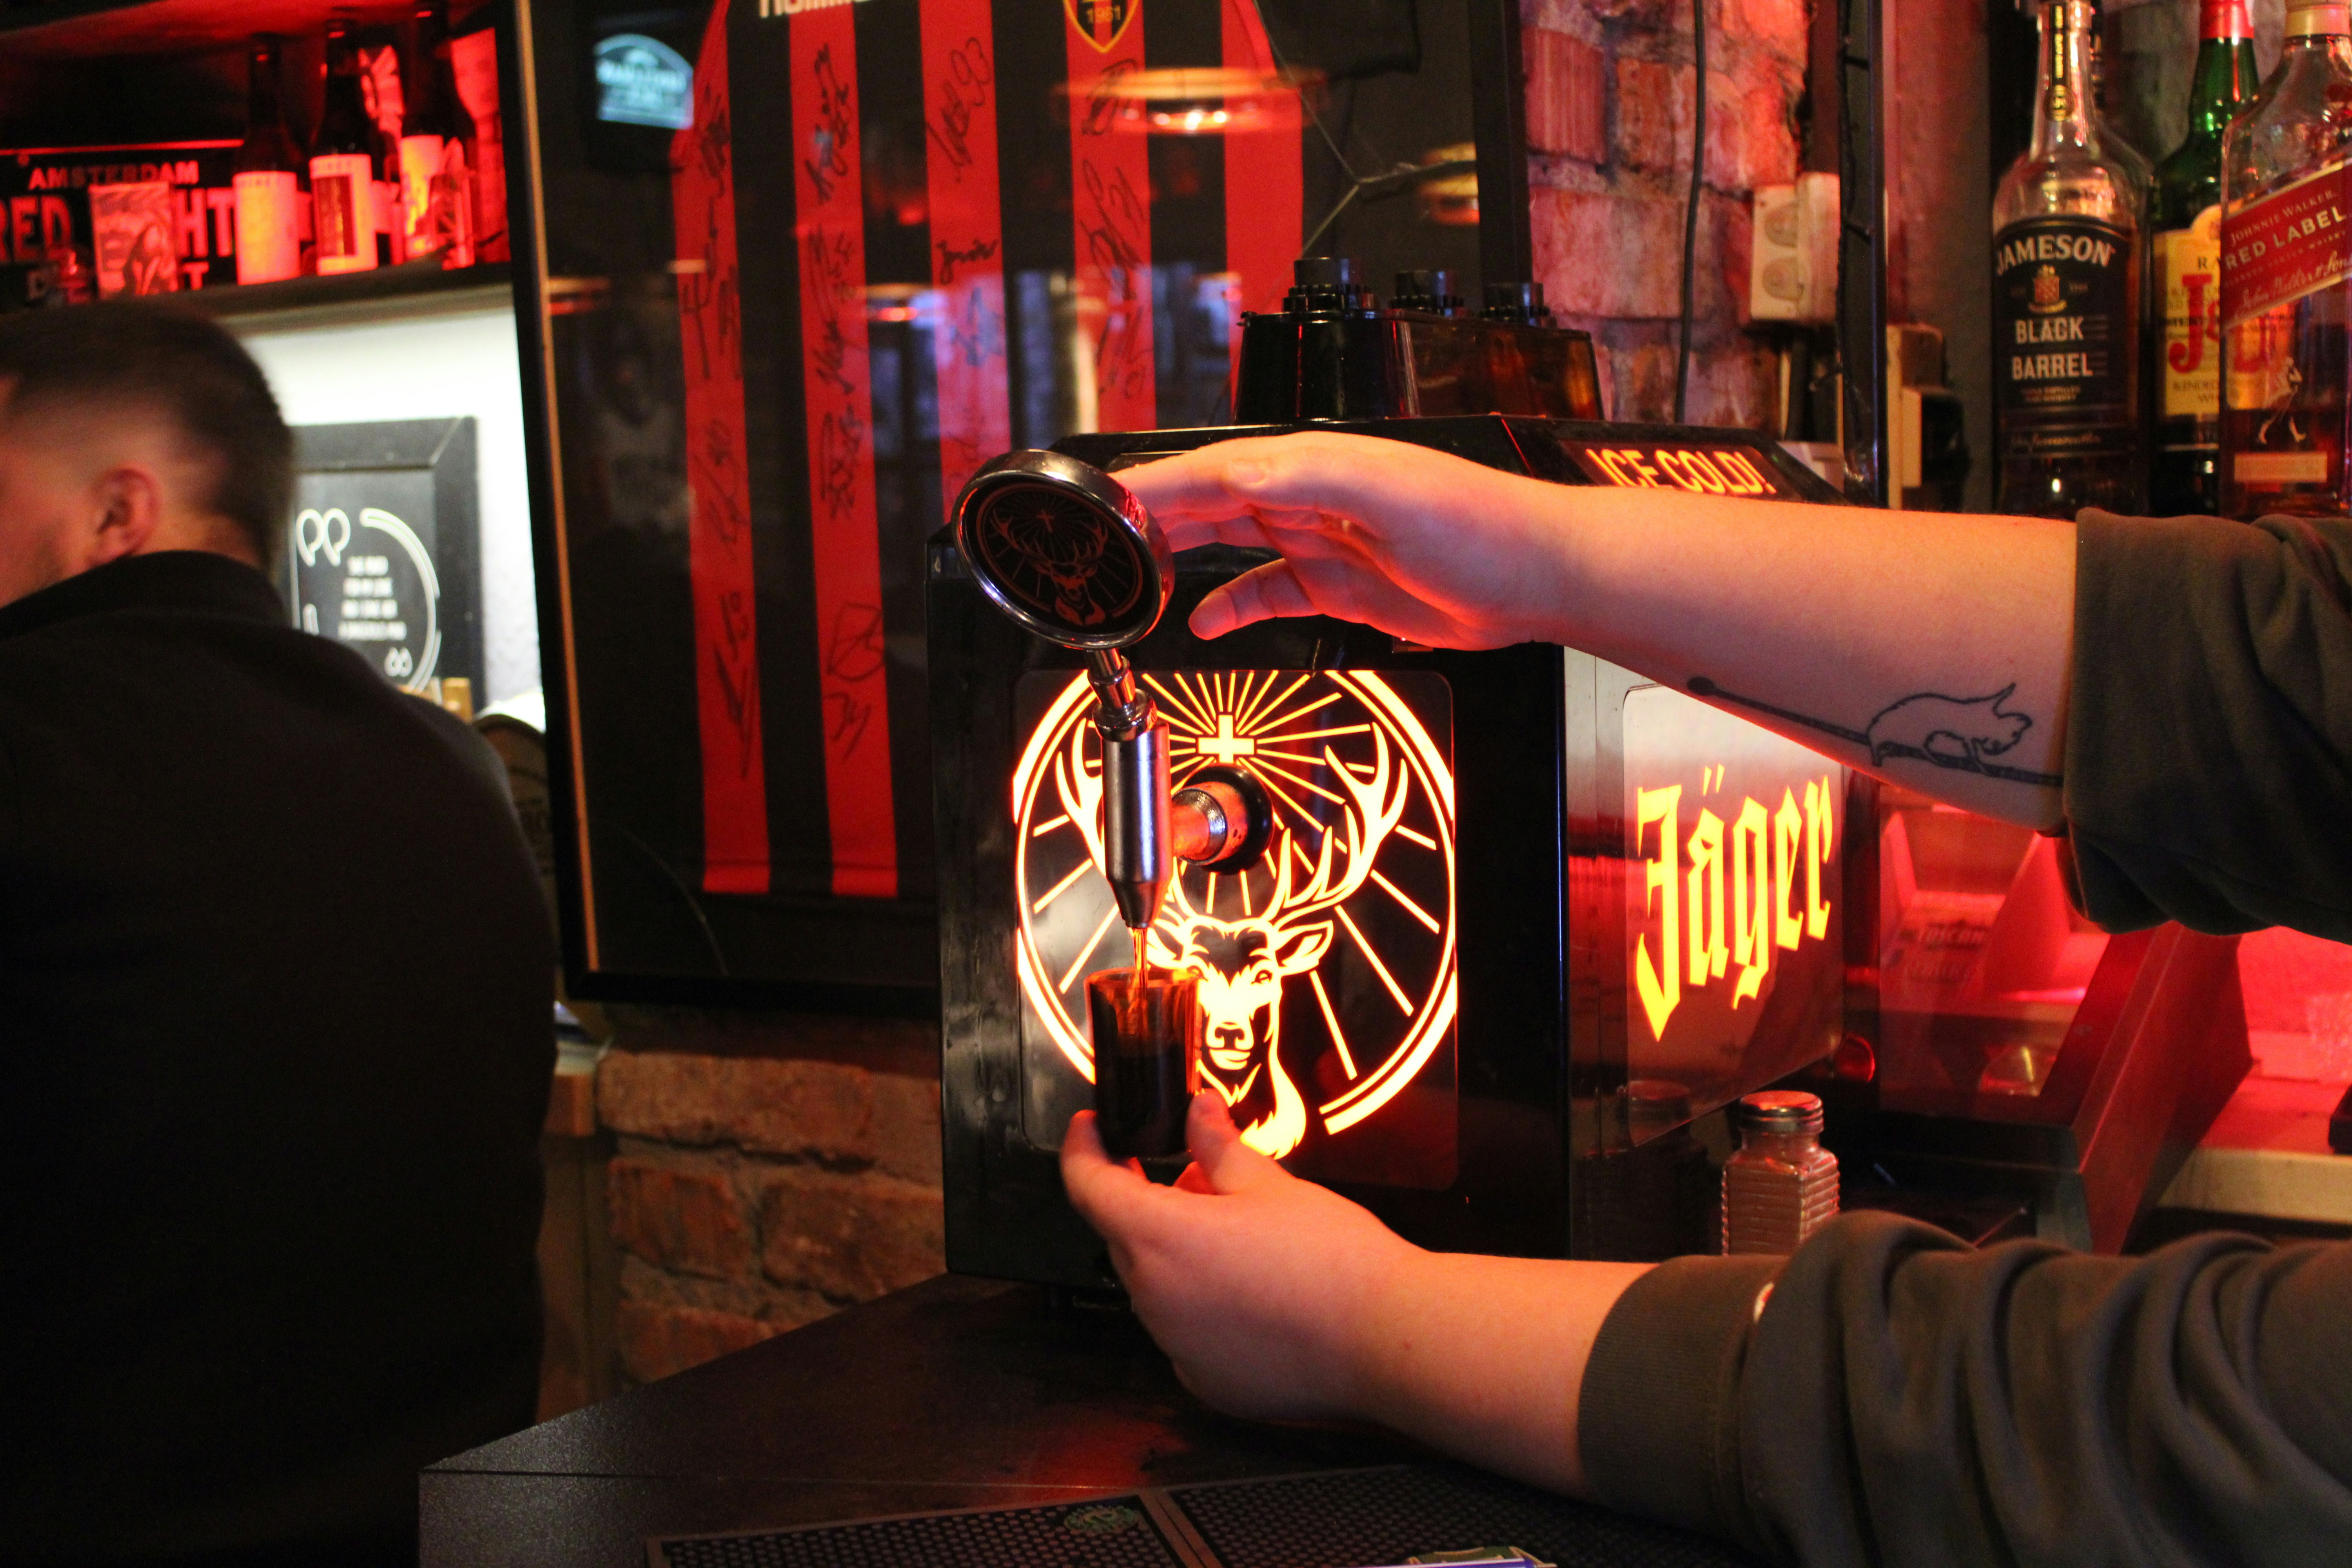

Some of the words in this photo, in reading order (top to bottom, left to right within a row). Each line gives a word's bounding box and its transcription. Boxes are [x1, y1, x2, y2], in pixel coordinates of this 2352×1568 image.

[28, 160, 199, 190] AMSTERDAM
[2225, 241, 2266, 270] RED
[2273, 206, 2347, 248] LABEL
[2230, 214, 2280, 247] JOHNNIE
[1997, 235, 2113, 276] JAMESON
[2015, 316, 2084, 345] BLACK
[2011, 353, 2094, 381] BARREL
[1585, 449, 1673, 488] ICE
[1654, 449, 1777, 494] COLD!
[1634, 762, 1833, 1042] Jäger
